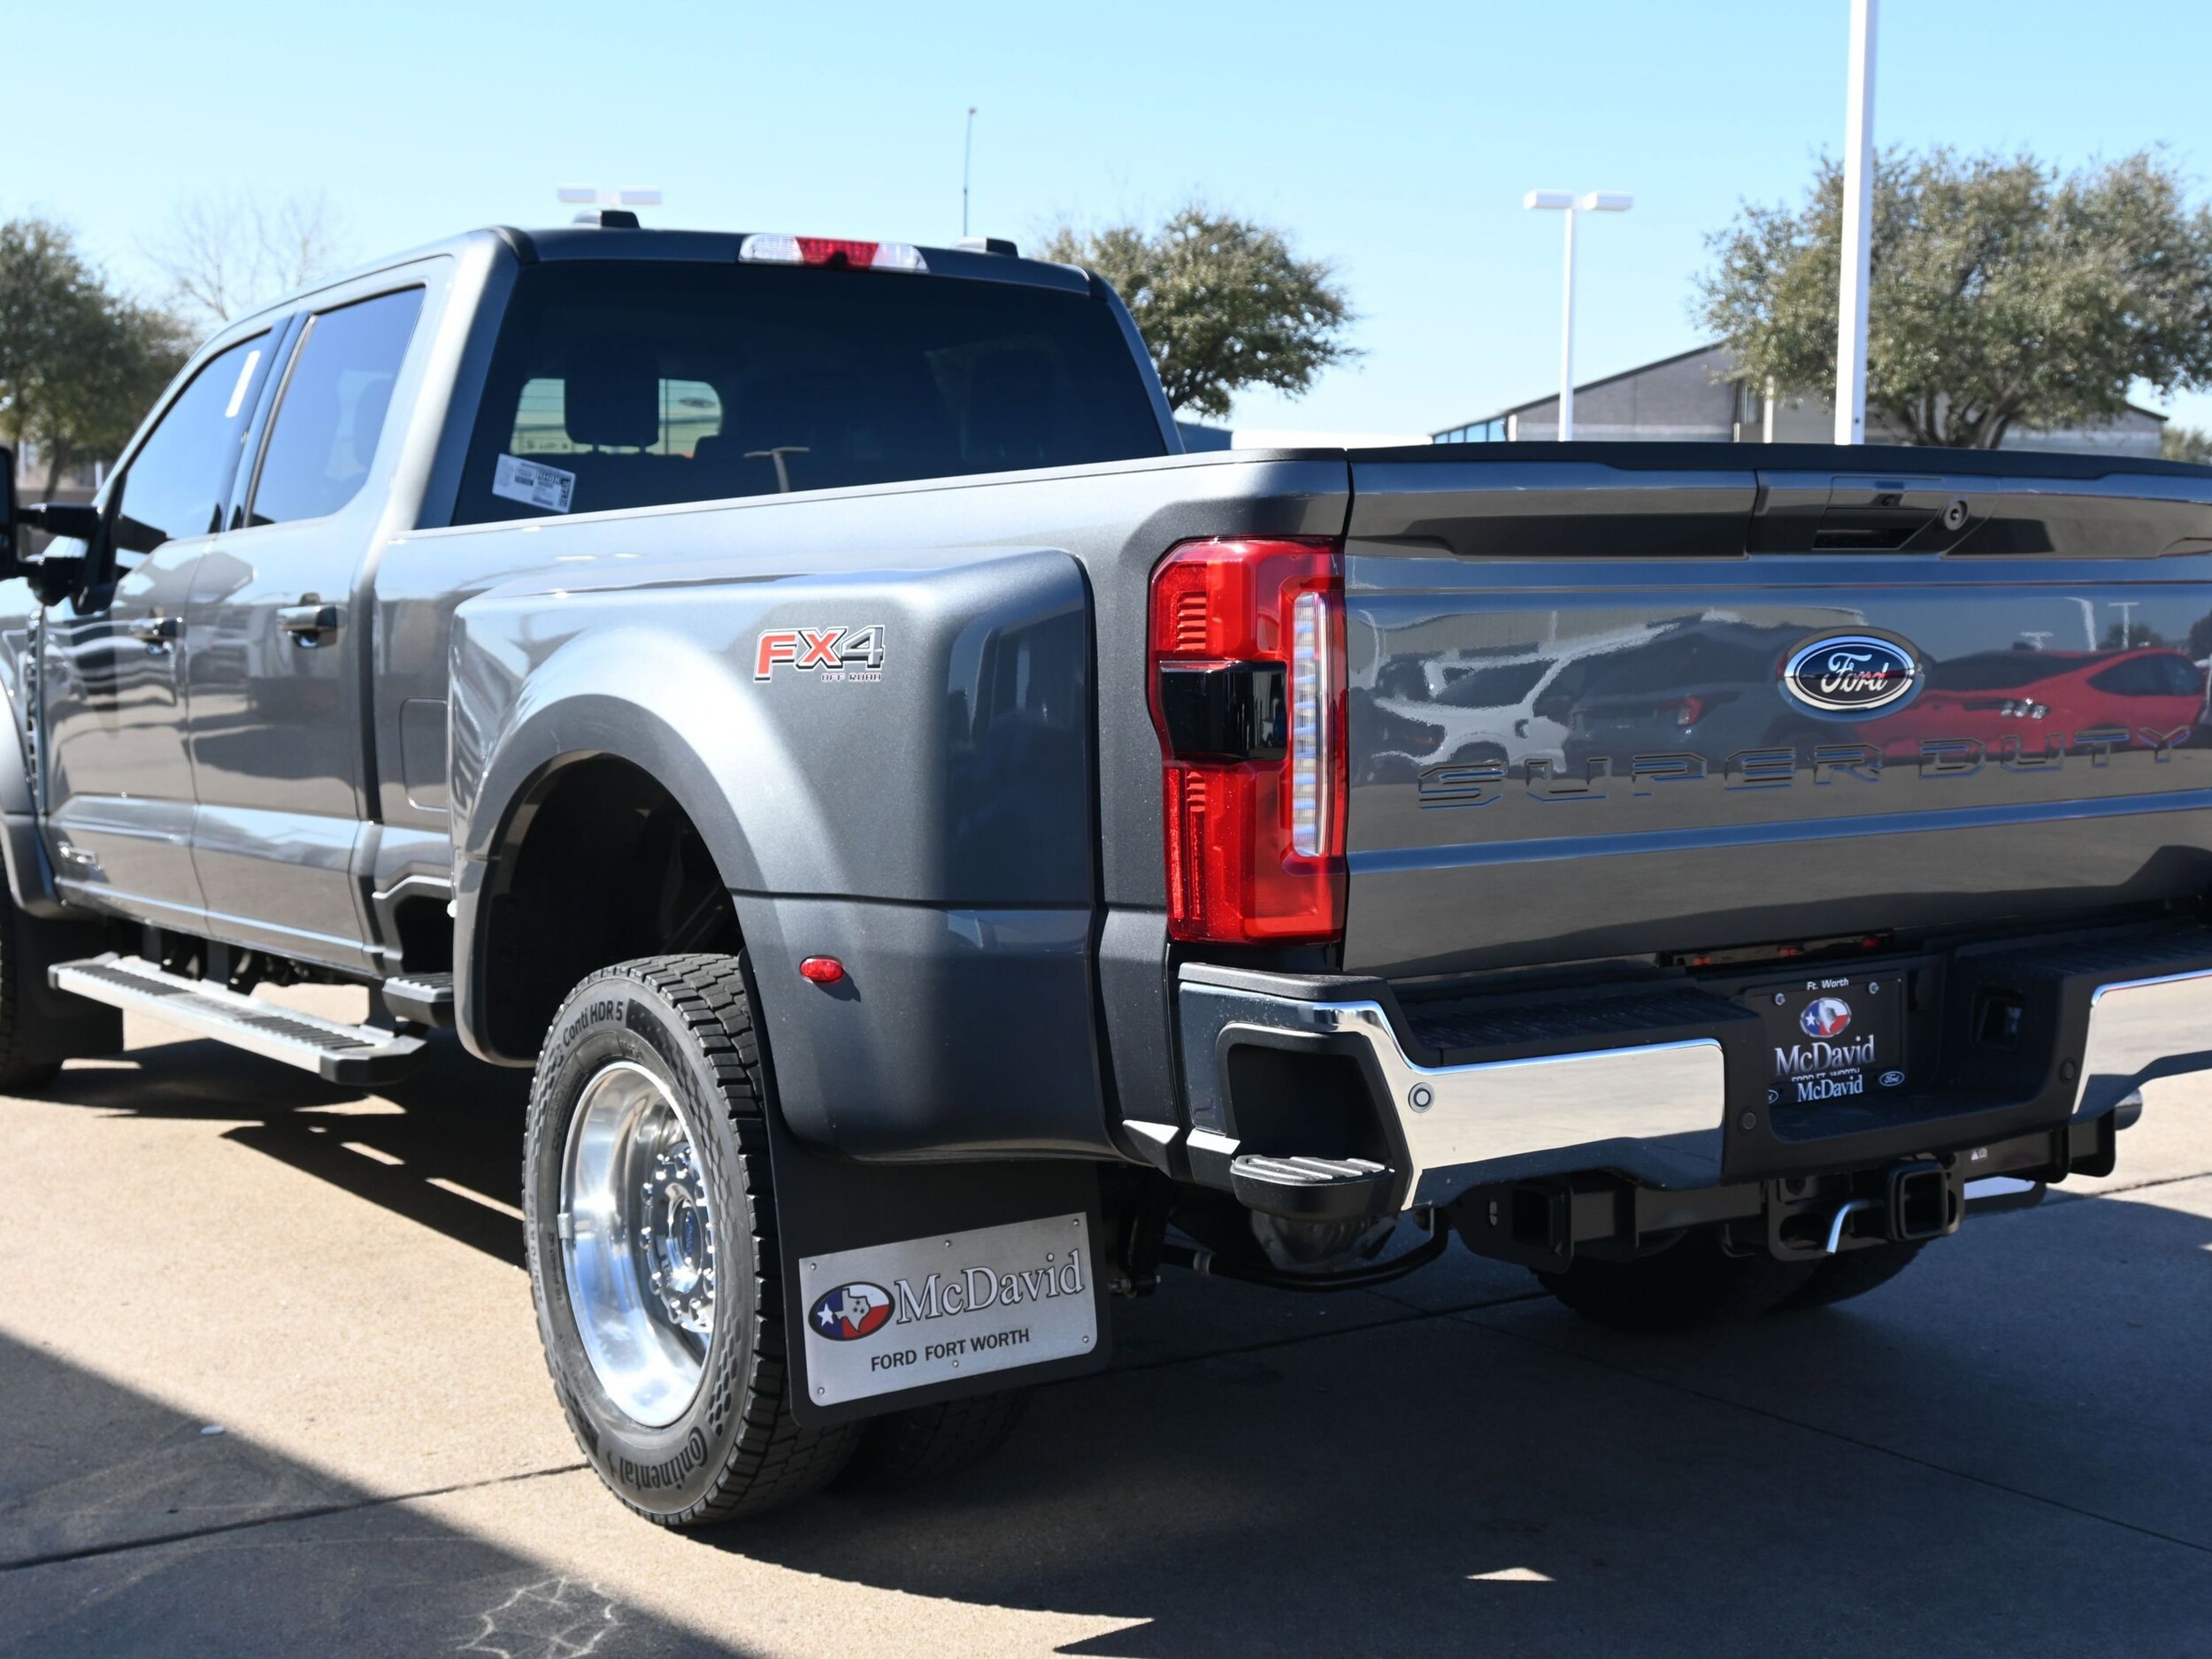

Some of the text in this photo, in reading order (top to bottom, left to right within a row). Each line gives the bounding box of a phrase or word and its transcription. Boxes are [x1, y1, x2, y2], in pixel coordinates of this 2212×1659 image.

[753, 625, 885, 683] FX4
[1820, 652, 1889, 693] Ford
[821, 672, 882, 682] OFF ROAD
[1417, 725, 2190, 810] SUPER DUTY
[1821, 977, 1849, 989] Worth
[563, 1000, 624, 1048] Conti HDR 5
[1774, 1033, 1877, 1077] McDavid
[1797, 1073, 1864, 1102] McDavid
[894, 1248, 1086, 1325] McDavid
[871, 1328, 1031, 1372] FORD FORT WORTH
[619, 1425, 708, 1491] Continental
